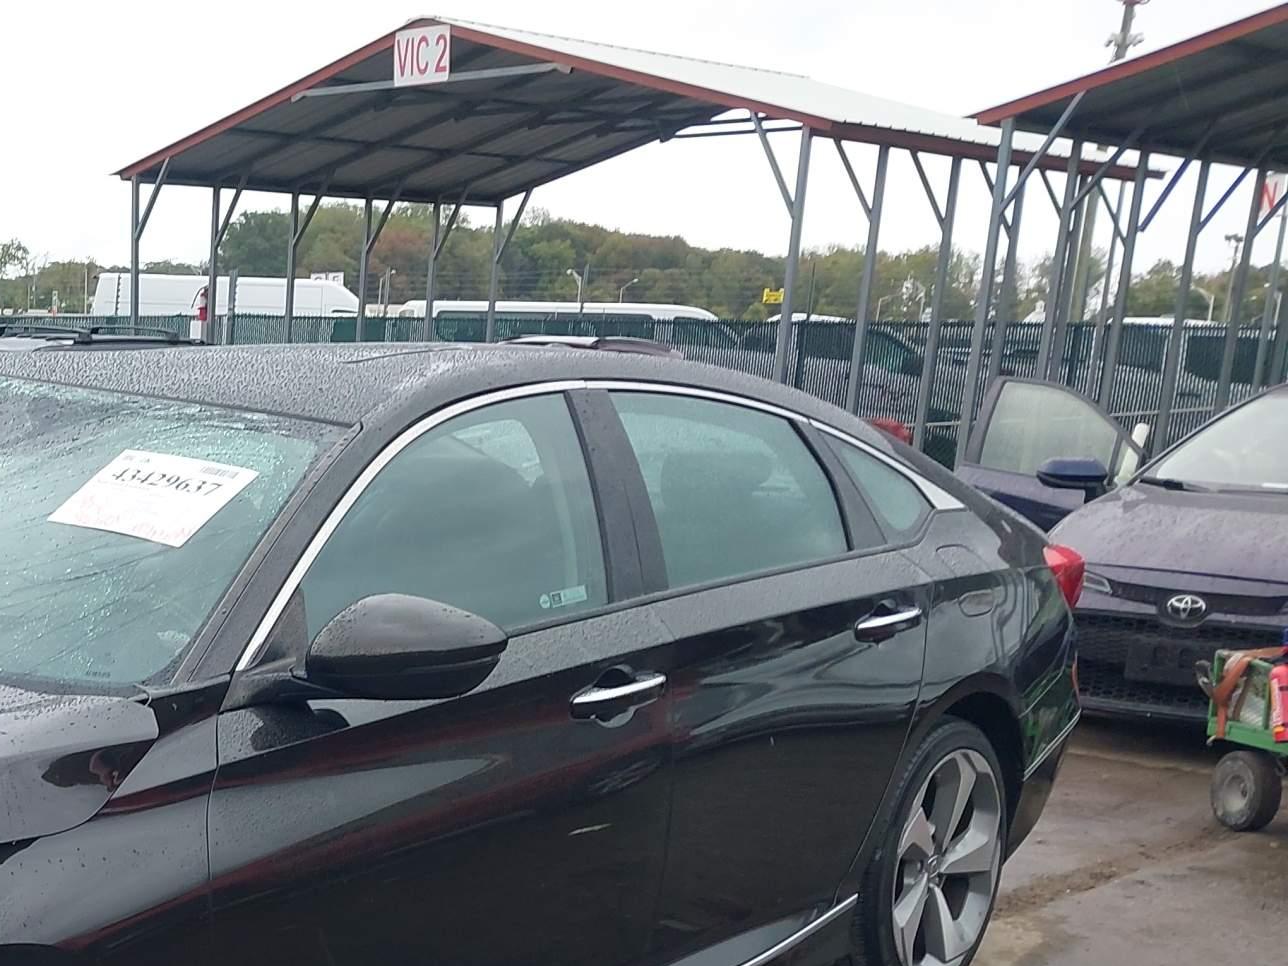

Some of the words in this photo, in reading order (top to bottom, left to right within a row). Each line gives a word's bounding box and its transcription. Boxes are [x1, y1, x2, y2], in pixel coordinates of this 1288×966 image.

[396, 36, 430, 77] VIC
[434, 33, 448, 73] 2
[112, 467, 224, 496] 43429637
